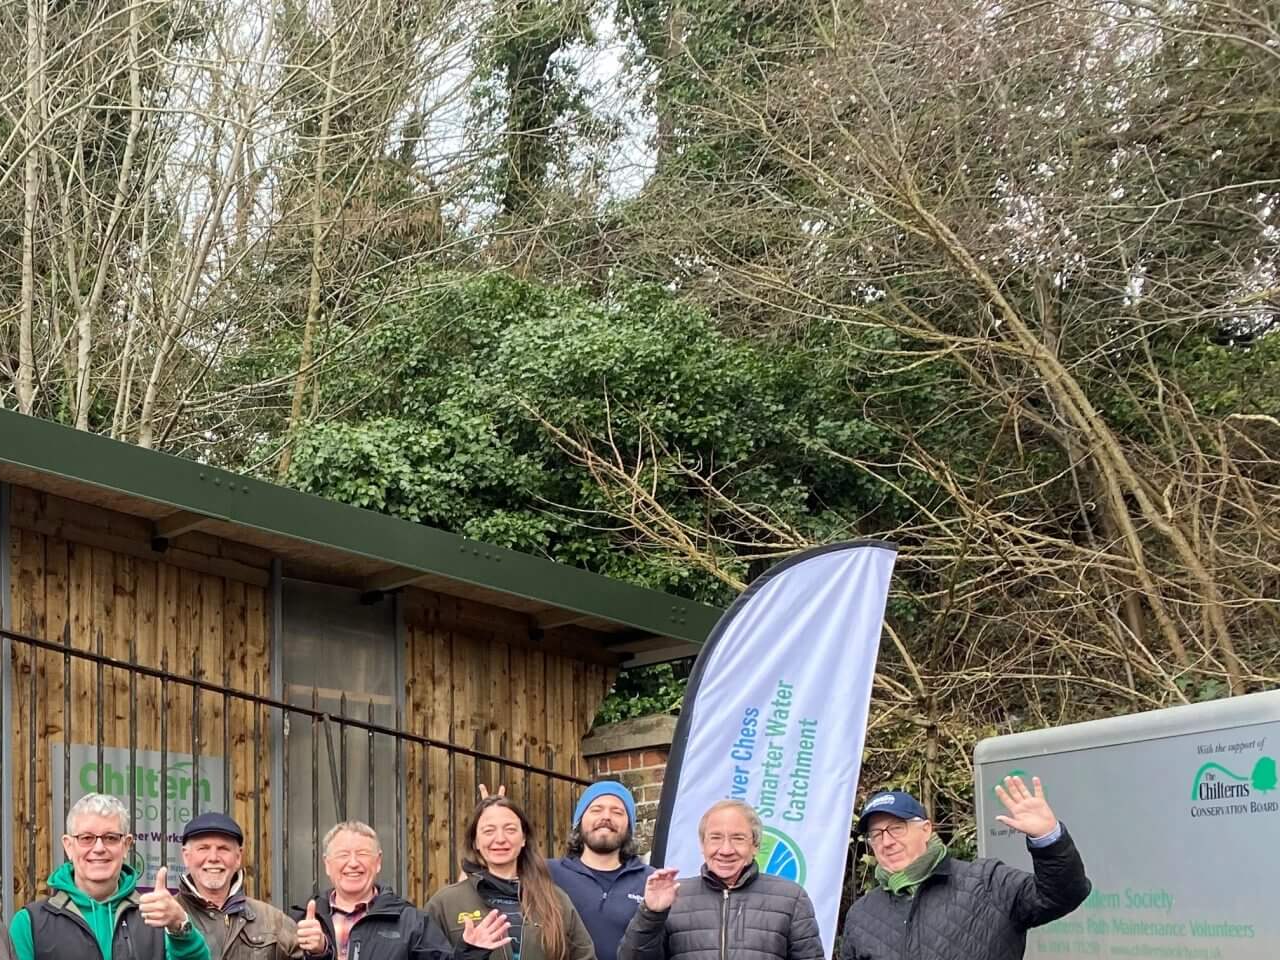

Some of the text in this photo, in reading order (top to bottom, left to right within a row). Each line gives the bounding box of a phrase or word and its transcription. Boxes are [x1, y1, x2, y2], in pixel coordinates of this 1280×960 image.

[725, 707, 759, 800] iver Chess
[756, 680, 793, 818] Smarter Water
[1215, 743, 1226, 752] the
[80, 762, 211, 802] Chiltern
[783, 718, 818, 821] Catchment
[1191, 801, 1279, 817] CONSERVATION BOARD
[1200, 782, 1250, 800] Chilterns
